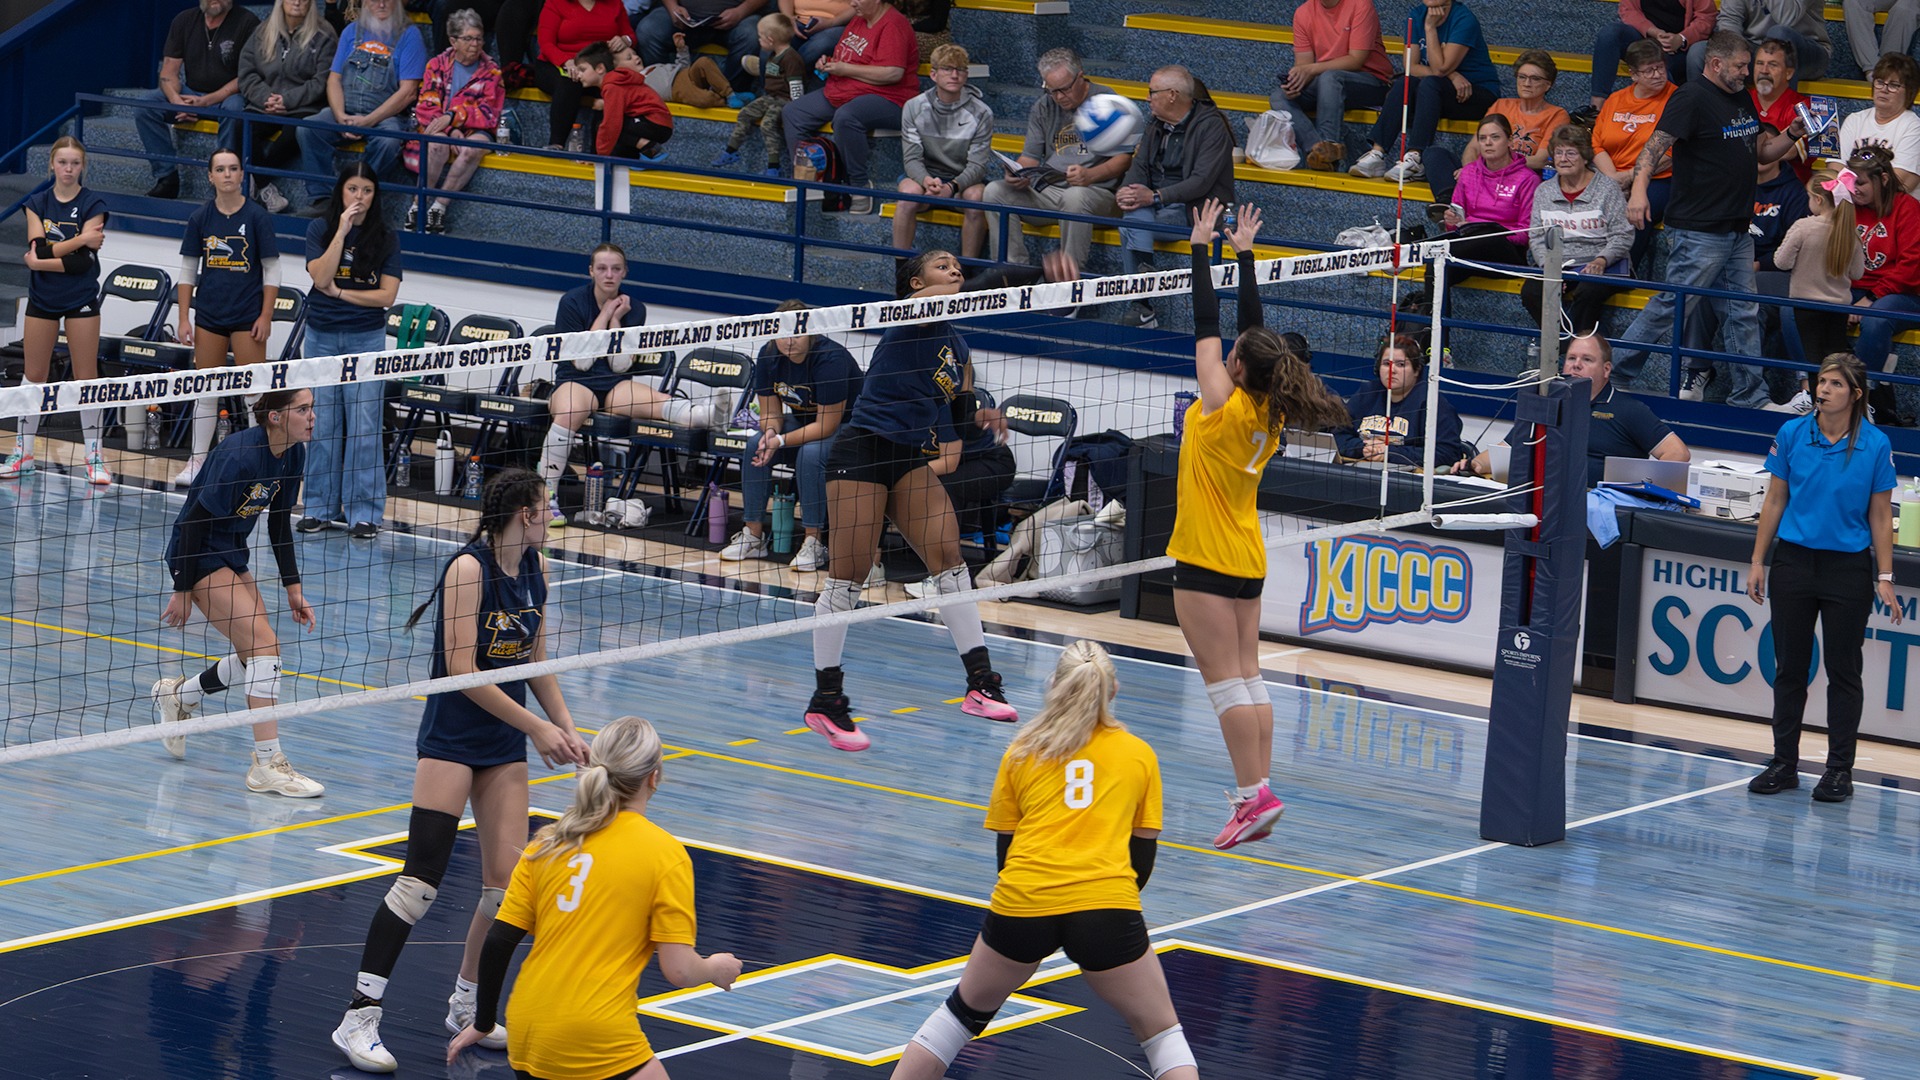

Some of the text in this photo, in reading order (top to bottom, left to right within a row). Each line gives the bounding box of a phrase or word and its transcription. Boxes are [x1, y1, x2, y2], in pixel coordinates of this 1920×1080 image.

[1053, 134, 1080, 144] HIGHL
[71, 207, 78, 218] 2
[238, 223, 246, 236] 4
[1291, 254, 1348, 275] HIGHLAND
[1408, 244, 1421, 263] H
[1221, 265, 1235, 286] H
[1269, 259, 1283, 281] H
[113, 274, 159, 291] SCOTTIES
[1070, 281, 1084, 303] H
[1095, 273, 1193, 297] HIGHLAND SCOTT
[273, 298, 295, 310] TIES
[878, 292, 1008, 323] HIGHLAND SCOTTIES
[1019, 287, 1033, 310] H
[793, 311, 810, 335] H
[851, 306, 867, 329] H
[460, 324, 510, 340] SCOTTIES
[607, 331, 625, 354] H
[638, 318, 780, 349] HIGHLAND SCOTTIES
[124, 345, 156, 358] HIGHLAND
[374, 343, 532, 375] HIGHLAND SCOTTIES
[545, 336, 562, 361] H
[270, 364, 289, 390] H
[340, 356, 359, 382] H
[689, 358, 742, 377] SCOTTIES
[40, 385, 60, 412] H
[78, 370, 253, 405] HIGHLAND SCOTTIES
[480, 399, 515, 413] HIGHLAND
[1005, 405, 1063, 424] SCOTTIES
[636, 425, 674, 438] HIGHLAND
[714, 437, 747, 449] HIGHLAN
[1246, 430, 1268, 474] 7
[1307, 536, 1466, 626] KJCCC
[1653, 558, 1769, 599] HIGHL
[1063, 758, 1094, 810] 8
[555, 852, 595, 914] 3
